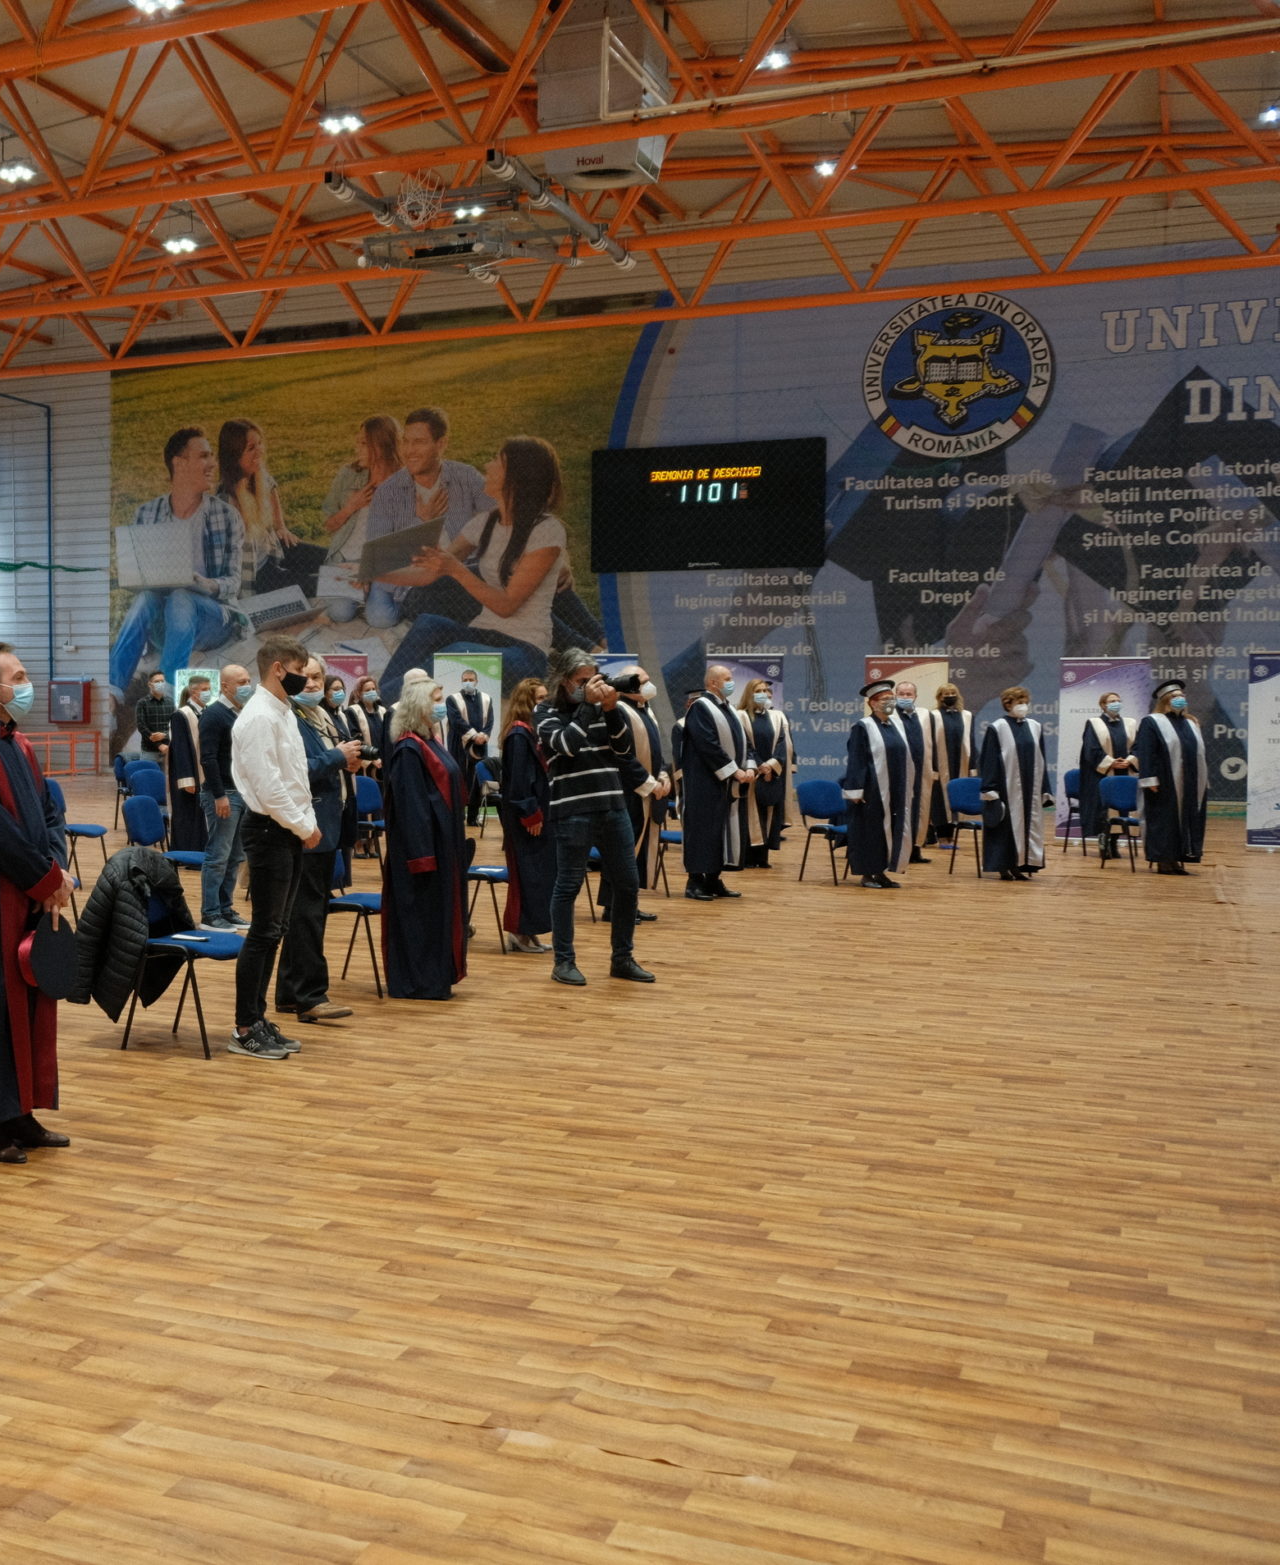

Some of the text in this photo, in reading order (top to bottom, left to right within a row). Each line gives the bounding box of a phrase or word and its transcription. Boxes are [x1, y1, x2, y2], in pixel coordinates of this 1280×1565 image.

[576, 153, 604, 166] Hoval
[1101, 297, 1280, 354] UNIV
[865, 293, 1050, 402] UNIVERSITATEA DIN ORADEA
[1184, 375, 1280, 424] DIN
[907, 429, 1002, 454] ROMÂNIA
[696, 468, 710, 479] DE
[712, 466, 762, 479] DESCHIDE
[845, 470, 1057, 491] Facultatea de Geografie,
[1084, 465, 1183, 481] Facultatea
[1188, 462, 1213, 477] de
[884, 493, 1015, 514] Turism și Sport
[1080, 487, 1140, 505] Relații
[1102, 505, 1265, 528] Științe Politice și
[1082, 526, 1280, 550] Științele Comunicări
[706, 571, 813, 586] Facultatea de
[888, 567, 1006, 583] Facultatea de
[1140, 561, 1272, 579] Facultatea de
[674, 590, 847, 610] Inginerie Managerială
[920, 589, 972, 607] Drept
[1109, 586, 1193, 603] Inginerie
[703, 612, 816, 630] și Tehnologică
[1083, 609, 1098, 627] și
[1104, 608, 1231, 626] Management
[705, 642, 812, 656] Facultatea de
[883, 643, 1001, 658] Facultatea de
[1135, 642, 1236, 657] Facultatea
[1150, 665, 1187, 680] cină
[1192, 664, 1208, 683] și
[810, 718, 855, 732] Vasil
